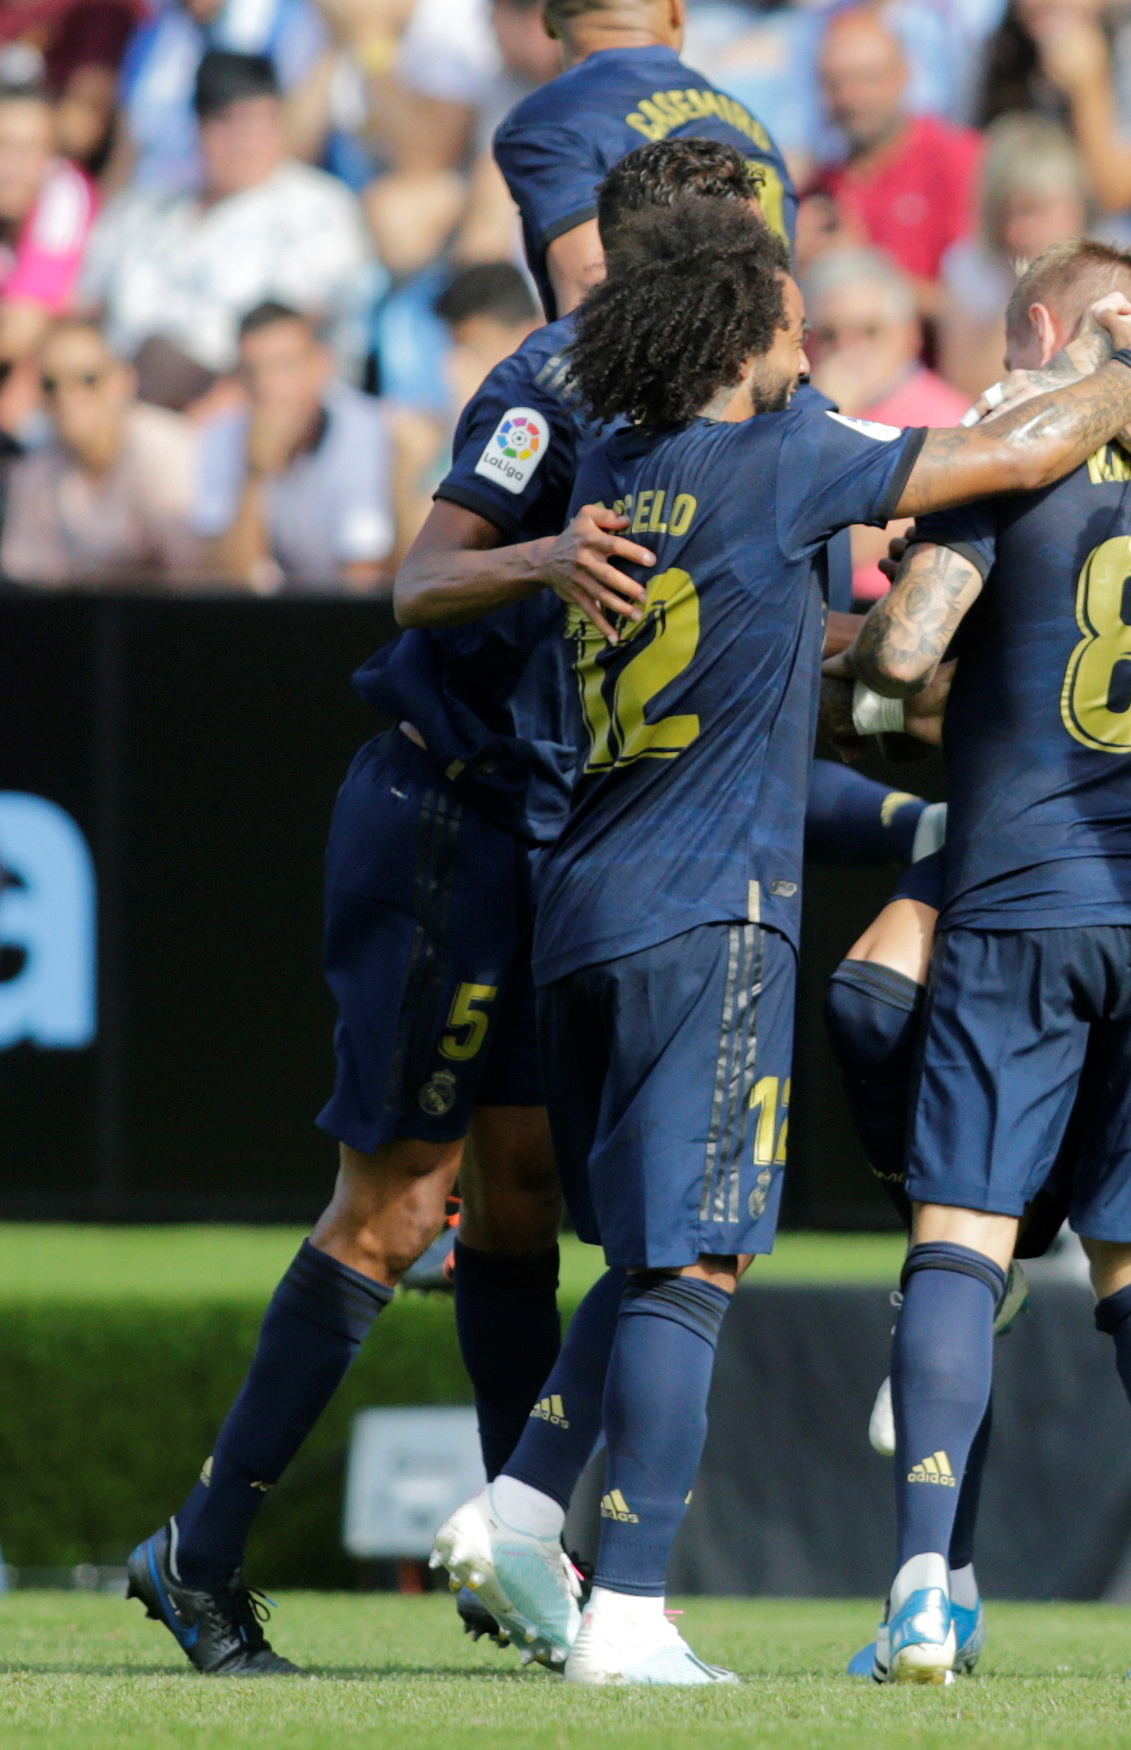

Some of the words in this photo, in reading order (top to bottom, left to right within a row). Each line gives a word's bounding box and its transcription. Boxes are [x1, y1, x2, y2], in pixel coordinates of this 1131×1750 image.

[625, 87, 772, 151] CASEMIRO
[482, 452, 525, 482] LaLiga
[564, 567, 700, 774] 12
[437, 982, 497, 1061] 5
[907, 1473, 955, 1487] adidas
